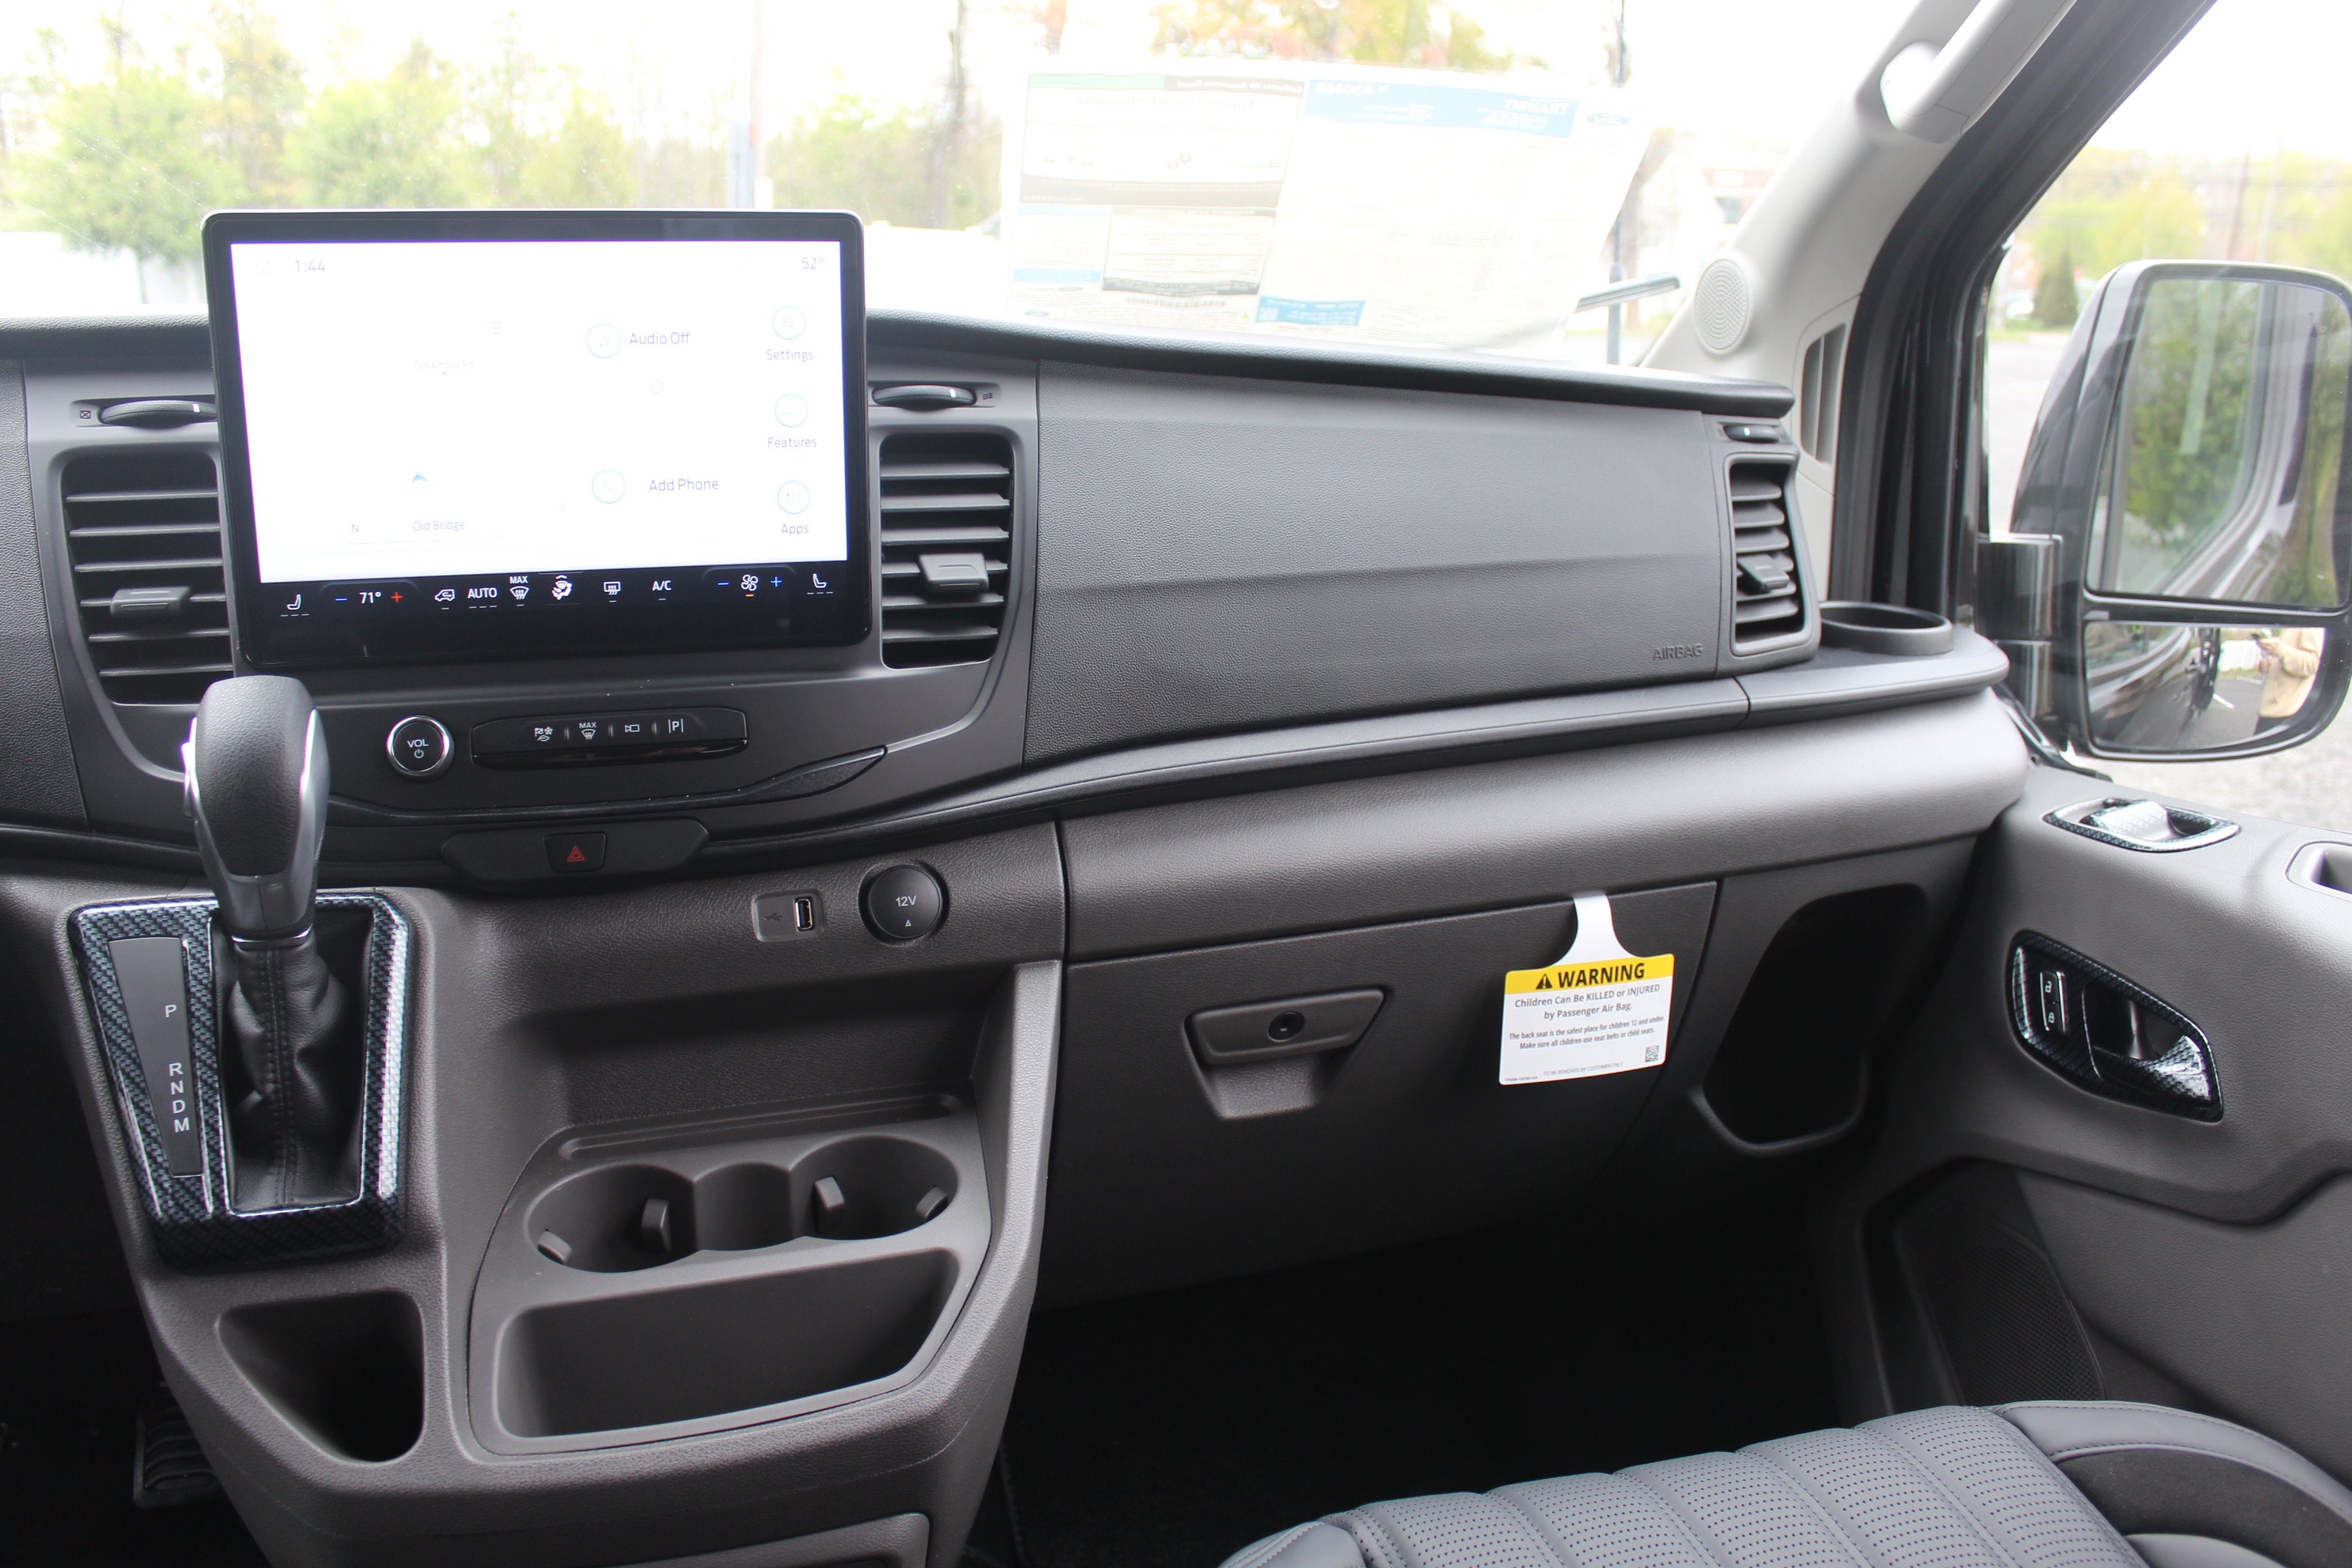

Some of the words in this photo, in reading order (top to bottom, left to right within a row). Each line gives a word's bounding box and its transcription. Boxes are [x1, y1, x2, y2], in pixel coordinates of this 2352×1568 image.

[294, 259, 326, 273] 1:44
[801, 257, 824, 270] 52°
[629, 332, 668, 346] Audio
[670, 331, 690, 345] Off
[766, 349, 814, 363] Settings
[767, 436, 817, 448] Features
[649, 479, 674, 492] Add
[677, 478, 719, 491] Phone
[351, 523, 359, 534] N
[413, 520, 431, 532] Old
[433, 519, 466, 534] Bridge
[781, 523, 809, 536] Apps
[509, 576, 529, 585] MAX
[651, 578, 672, 593] A/C
[359, 590, 382, 605] 71°
[467, 586, 498, 601] AUTO
[1652, 643, 1704, 661] AIRBAG
[578, 721, 598, 730] MAX
[407, 739, 429, 749] VOL
[896, 894, 917, 907] 12V
[1558, 962, 1645, 988] WARNING
[1515, 996, 1552, 1007] Children
[1555, 995, 1571, 1004] Can
[1573, 994, 1584, 1002] Be
[1586, 990, 1615, 1001] KILLED
[1627, 984, 1661, 996] INJURED
[165, 1004, 178, 1018] P
[1544, 1011, 1555, 1020] by
[1556, 1005, 1600, 1018] Passenger
[1601, 1003, 1614, 1013] Air
[1616, 1002, 1633, 1013] Bag.
[1567, 1026, 1583, 1035] safest
[1584, 1025, 1598, 1034] place
[1608, 1021, 1630, 1030] children
[1520, 1041, 1536, 1049] Make
[1559, 1037, 1582, 1046] children
[1606, 1032, 1620, 1041] belts
[1627, 1028, 1640, 1037] child
[1640, 1027, 1655, 1035] seats.
[169, 1062, 183, 1077] R
[1558, 1066, 1580, 1075] REMOVED
[170, 1081, 184, 1094] N
[172, 1099, 186, 1115] D
[174, 1118, 191, 1133] M
